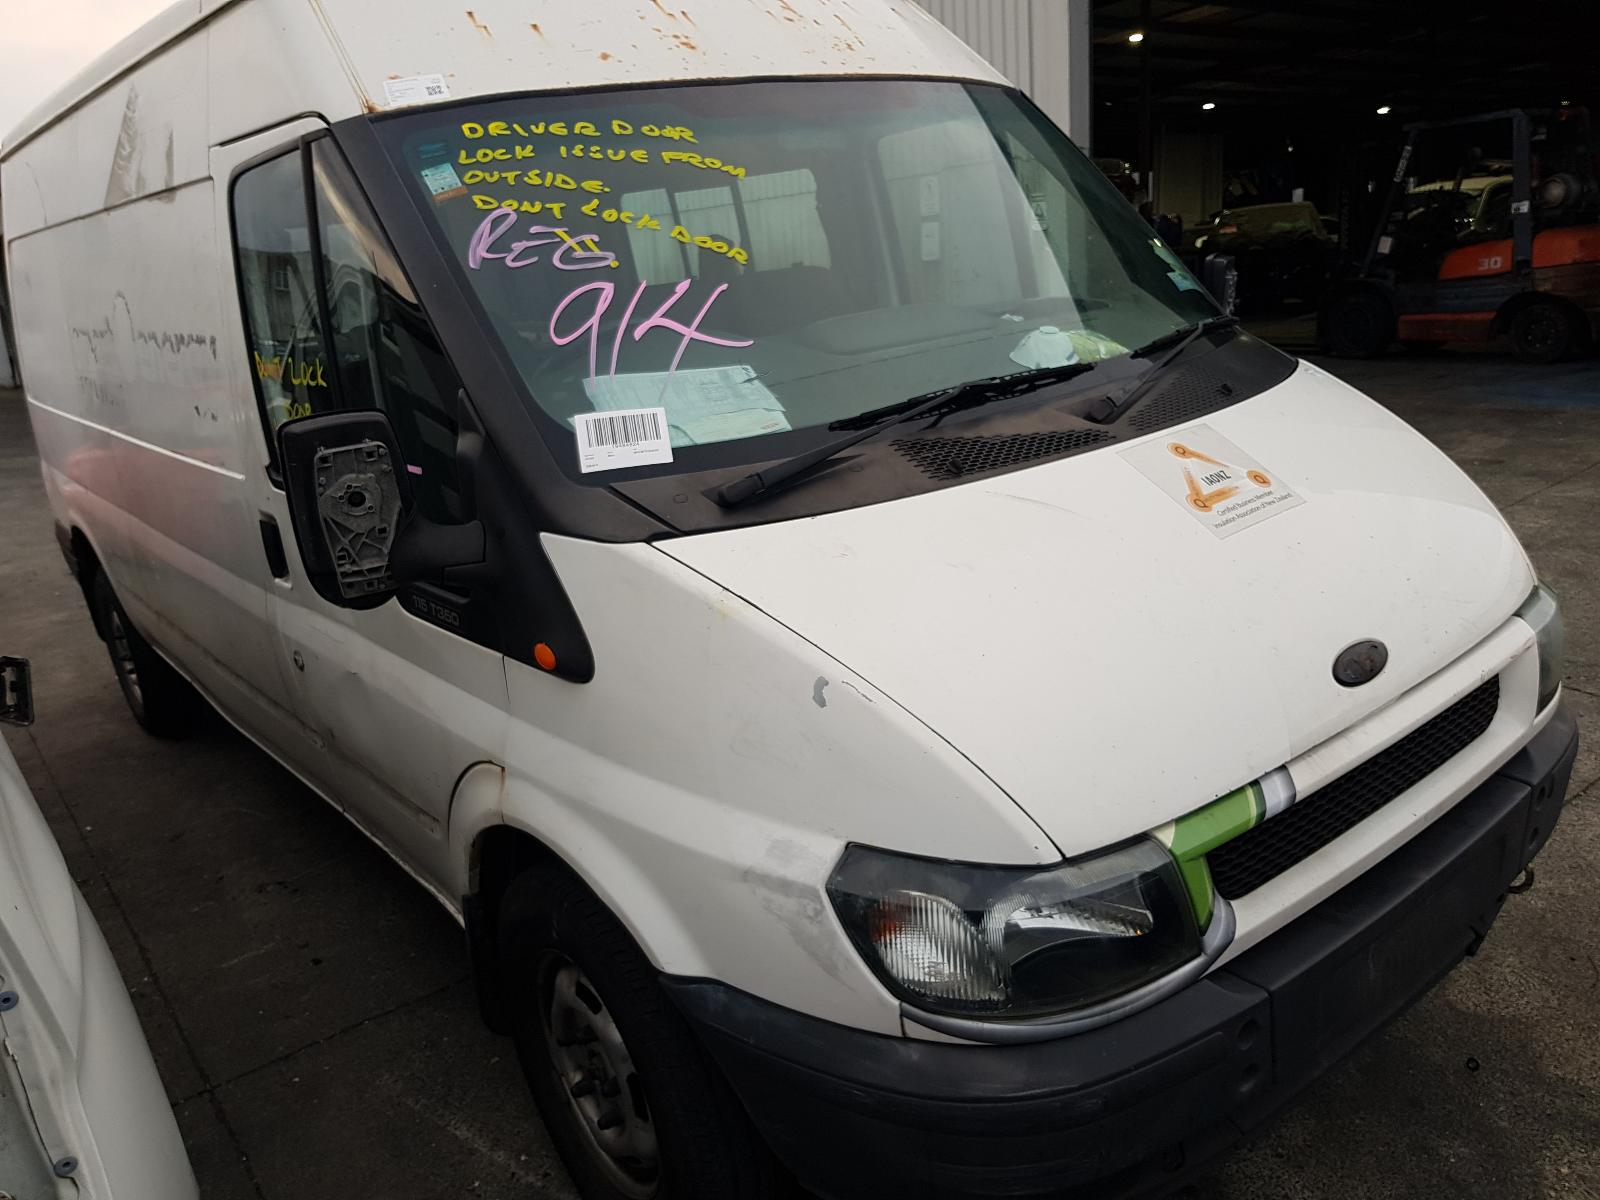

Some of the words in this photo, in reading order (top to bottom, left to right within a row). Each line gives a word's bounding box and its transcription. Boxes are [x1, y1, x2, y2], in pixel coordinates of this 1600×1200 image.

[461, 121, 601, 139] DRIVER
[612, 119, 698, 143] DOOR
[458, 145, 535, 165] LOCK
[560, 145, 649, 163] ISSUE
[661, 150, 747, 180] FROM
[580, 198, 661, 231] LOCK
[670, 225, 750, 266] DOOR
[1478, 256, 1502, 271] 30
[549, 277, 755, 400] 914
[1200, 469, 1232, 487] IAONZ
